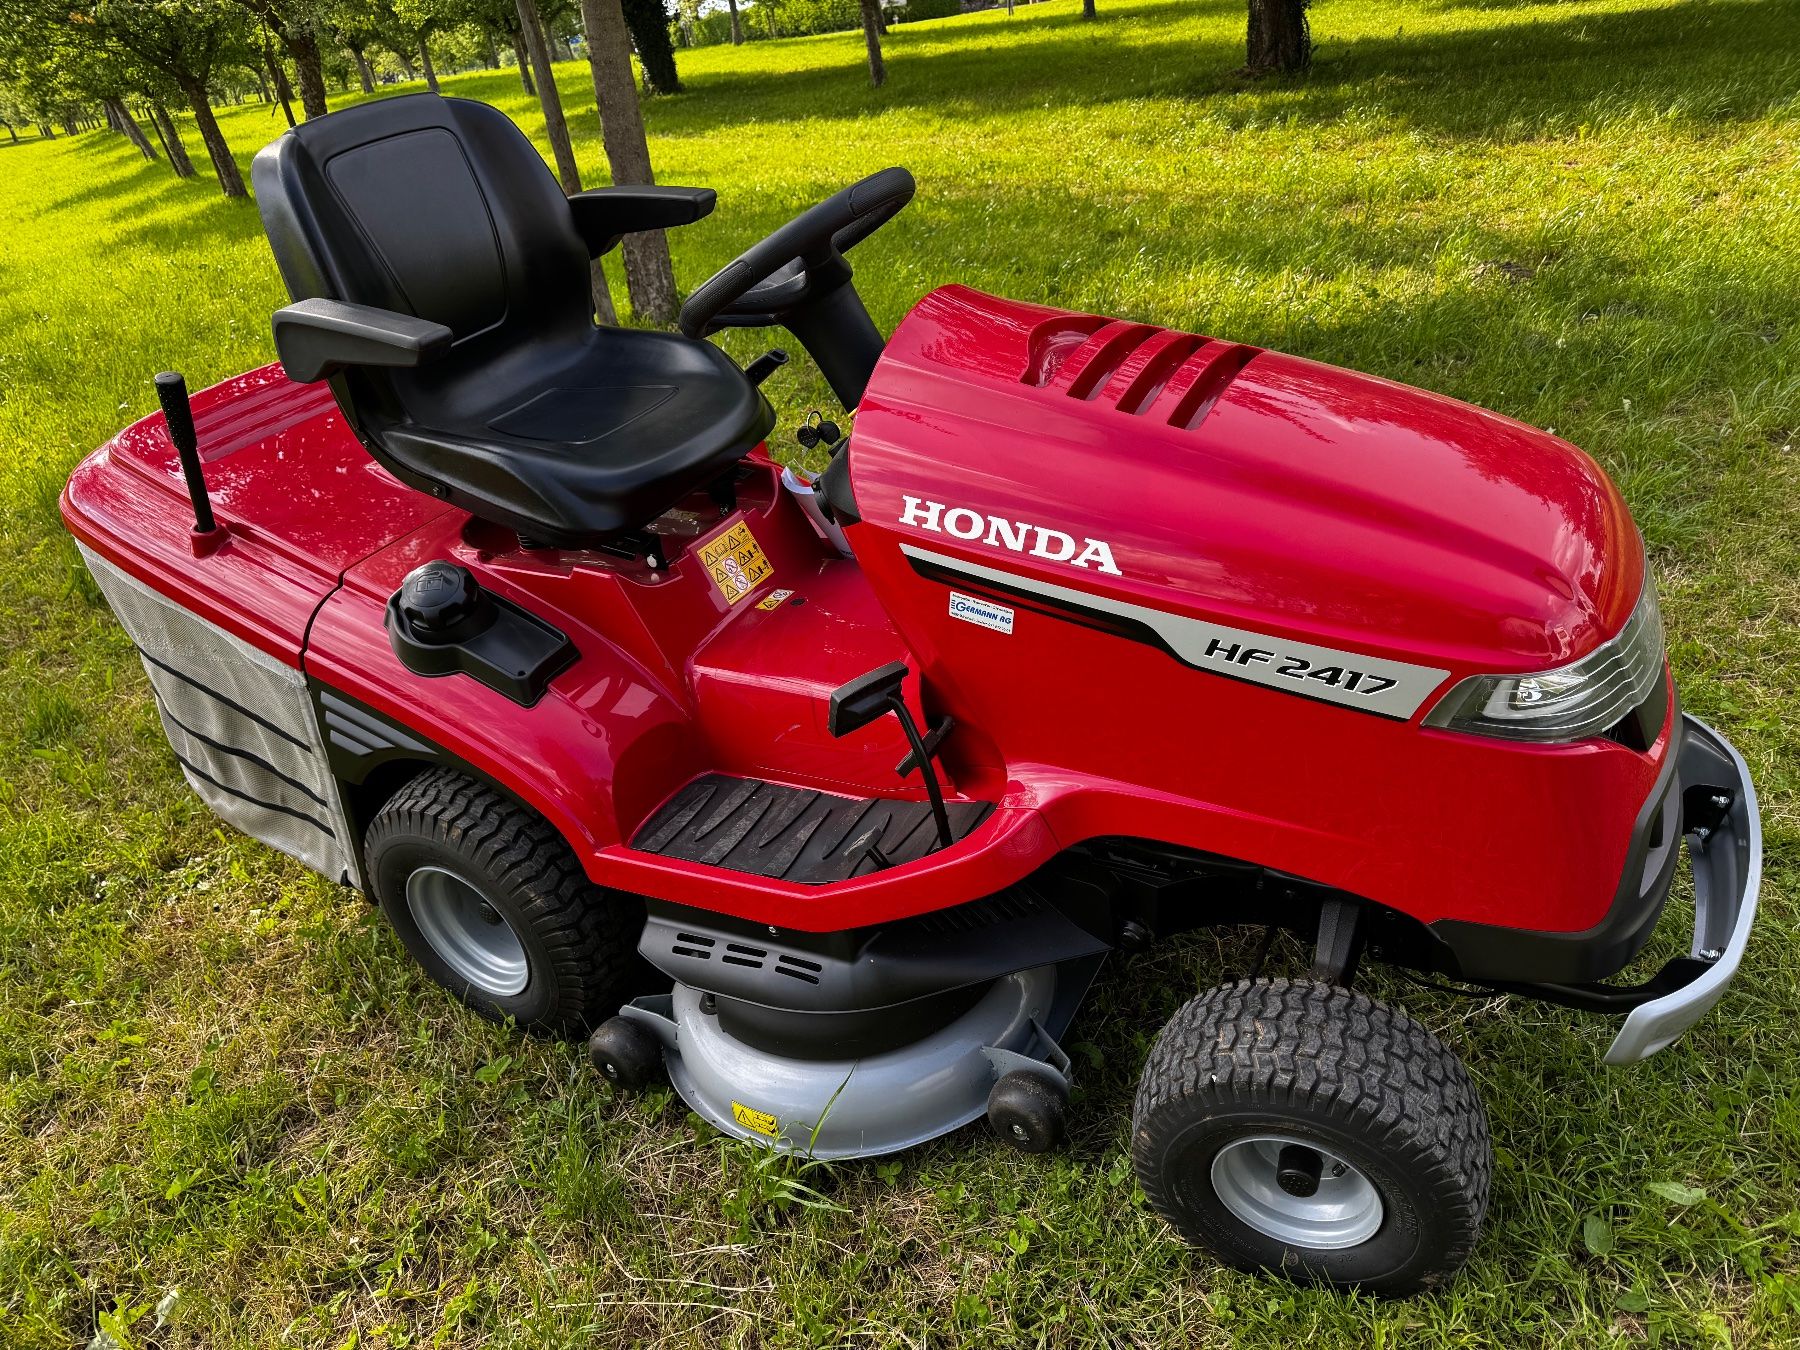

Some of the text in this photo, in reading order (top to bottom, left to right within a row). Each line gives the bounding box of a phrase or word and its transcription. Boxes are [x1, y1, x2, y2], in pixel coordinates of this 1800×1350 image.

[899, 494, 1122, 576] HONDA
[956, 601, 998, 620] GERMANN
[999, 615, 1012, 624] AG
[1203, 638, 1399, 696] HF 2417
